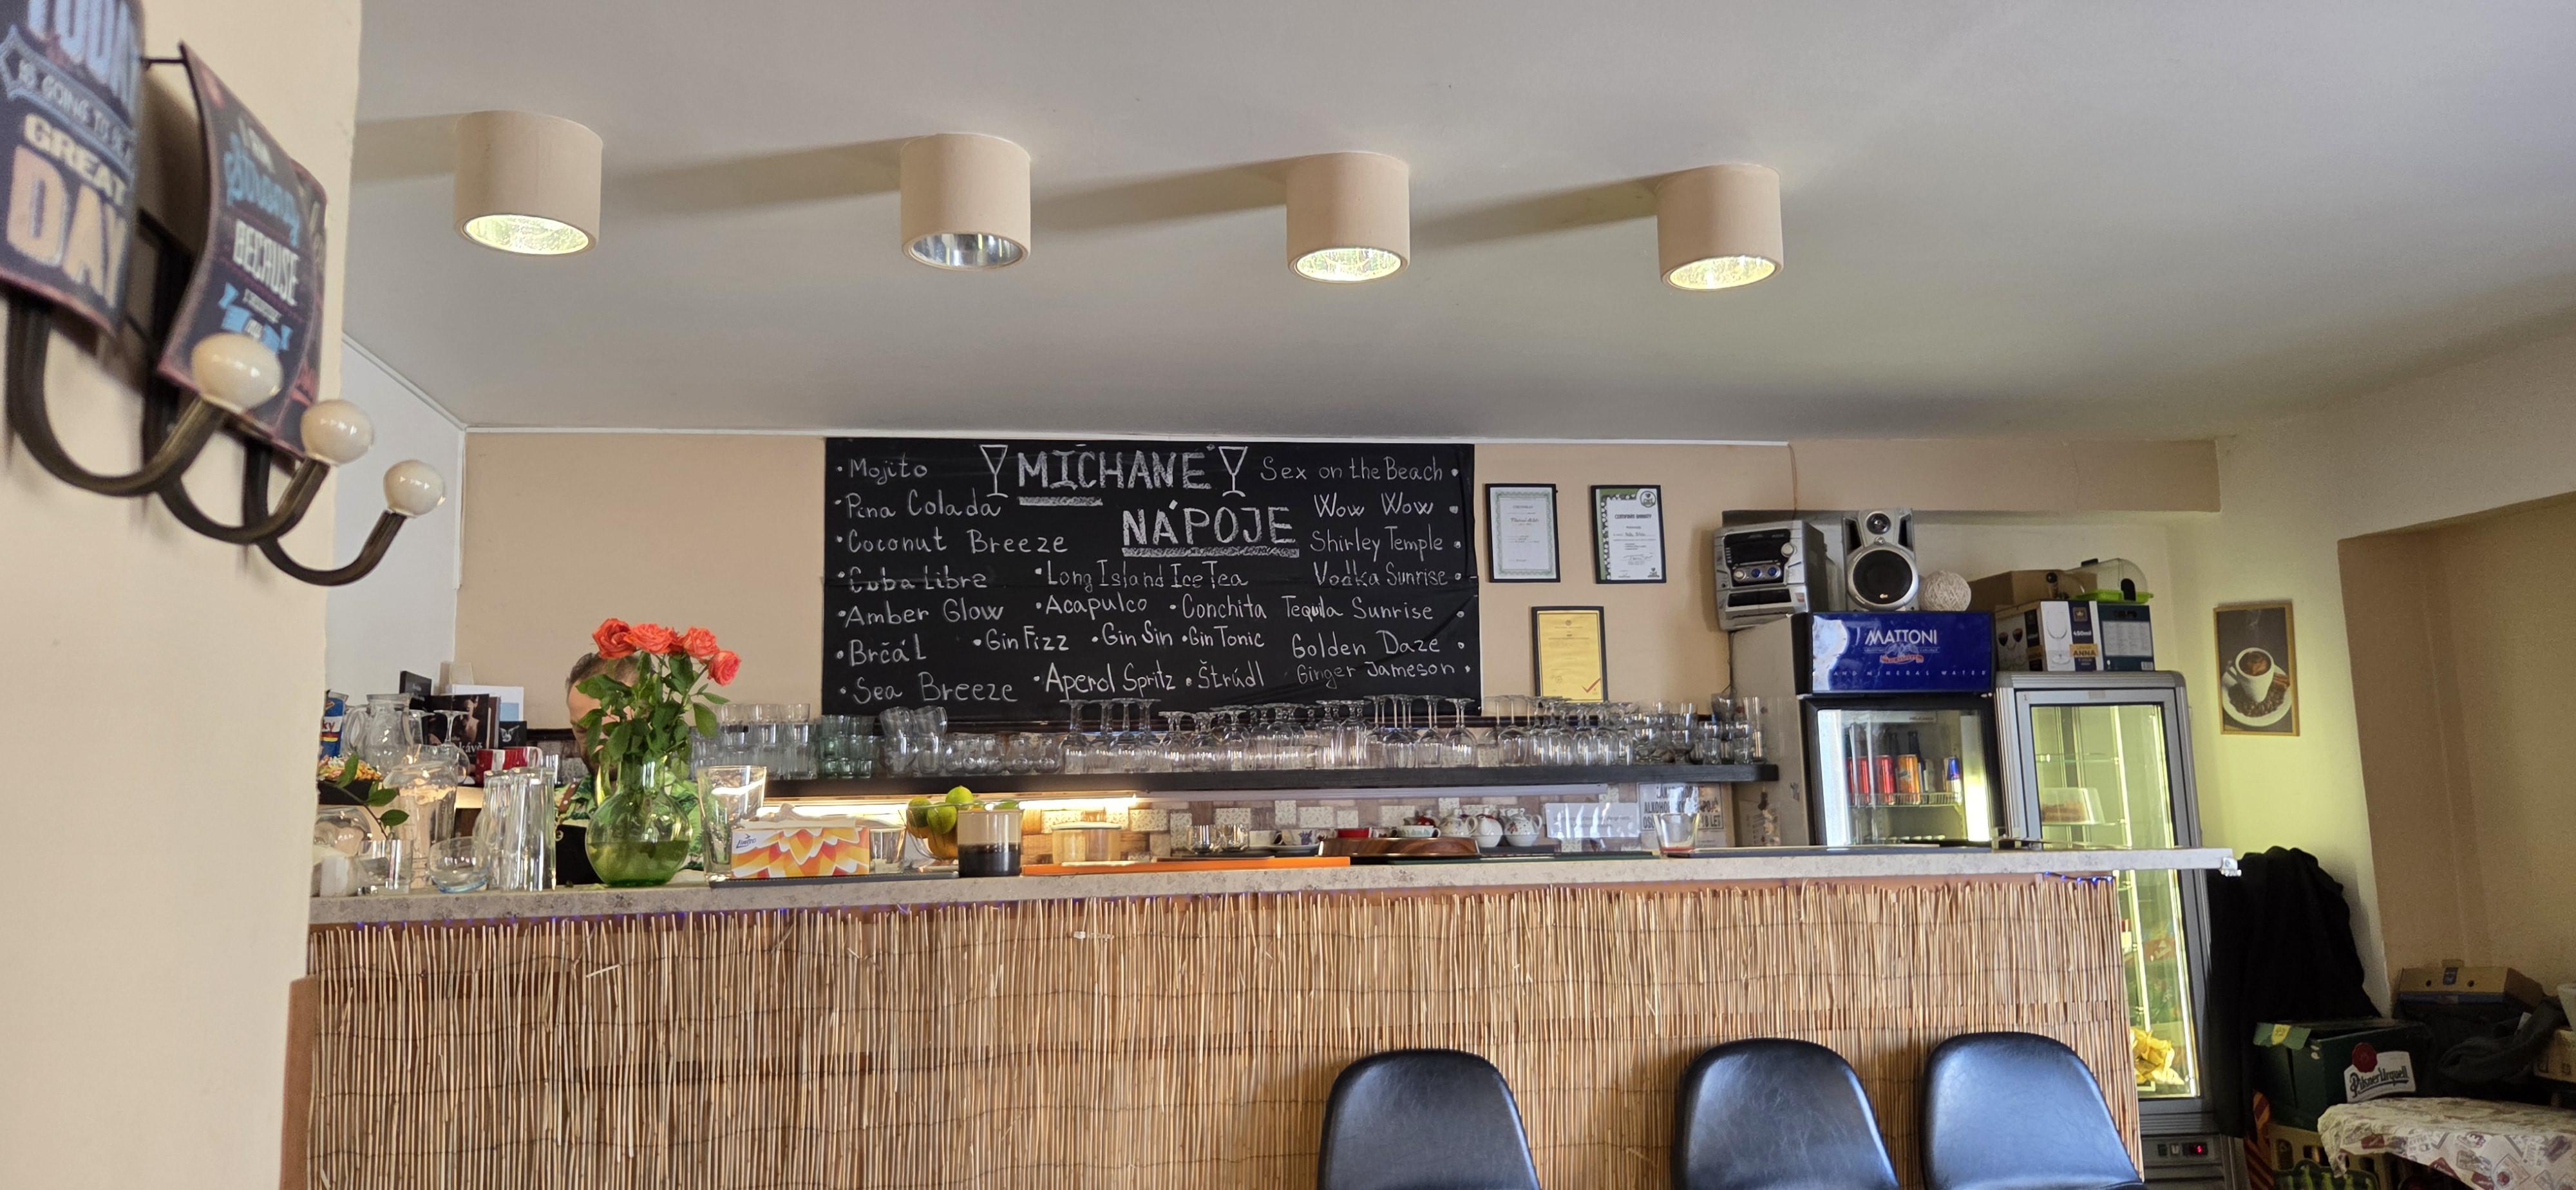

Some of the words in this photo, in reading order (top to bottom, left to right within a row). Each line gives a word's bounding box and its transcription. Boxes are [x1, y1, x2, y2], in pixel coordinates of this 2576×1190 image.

[24, 113, 127, 205] GREAT
[6, 144, 128, 310] DAY
[233, 218, 299, 307] BECAUSE
[849, 452, 928, 485] Mojito
[1260, 457, 1307, 481] Sex
[1318, 466, 1343, 480] on
[1350, 457, 1381, 480] the
[1384, 456, 1443, 481] Beach
[846, 492, 896, 518] Pina
[907, 487, 1001, 516] Colada
[1314, 492, 1365, 518] Wow
[1381, 491, 1434, 515] Wow
[1122, 500, 1296, 546] NÁPOJE
[848, 526, 947, 552] Coconut
[967, 529, 1069, 554] Breeze
[1310, 529, 1381, 562] Shirley
[1385, 524, 1443, 562] Temple
[849, 567, 915, 592] Cuba
[925, 565, 988, 590] Libre
[1048, 560, 1093, 592] Long
[1097, 560, 1164, 589] Island
[1170, 563, 1203, 589] Ice
[1202, 561, 1249, 589] Tea
[1314, 560, 1379, 587] Vodka
[1385, 561, 1448, 587] Sunrise
[845, 601, 929, 628] Amber
[943, 598, 1004, 622] Glow
[1046, 592, 1147, 620] Acapulco
[1182, 594, 1267, 619] Conchita
[1282, 595, 1344, 621] Tequila
[1353, 597, 1434, 620] Sunrise
[986, 628, 1019, 650] Gin
[1023, 625, 1070, 650] Fizz
[1102, 622, 1137, 647] Gin
[1142, 620, 1173, 647] Sin
[1188, 627, 1213, 647] Gin
[1213, 625, 1265, 648] Tonic
[1291, 631, 1366, 659] Golden
[1376, 630, 1441, 656] Daze
[1865, 629, 1937, 646] MATTONI
[853, 676, 902, 704] Sea
[918, 672, 1018, 703] Breeze
[1045, 662, 1115, 700] Aperol
[1122, 661, 1176, 697] Spritz
[1198, 659, 1264, 690] Štrúdl
[1297, 665, 1357, 690] Ginger
[1364, 661, 1455, 678] Jameson
[1710, 815, 1721, 827] LET
[2349, 1072, 2380, 1098] Pilsner
[2378, 1065, 2409, 1086] Urquell
